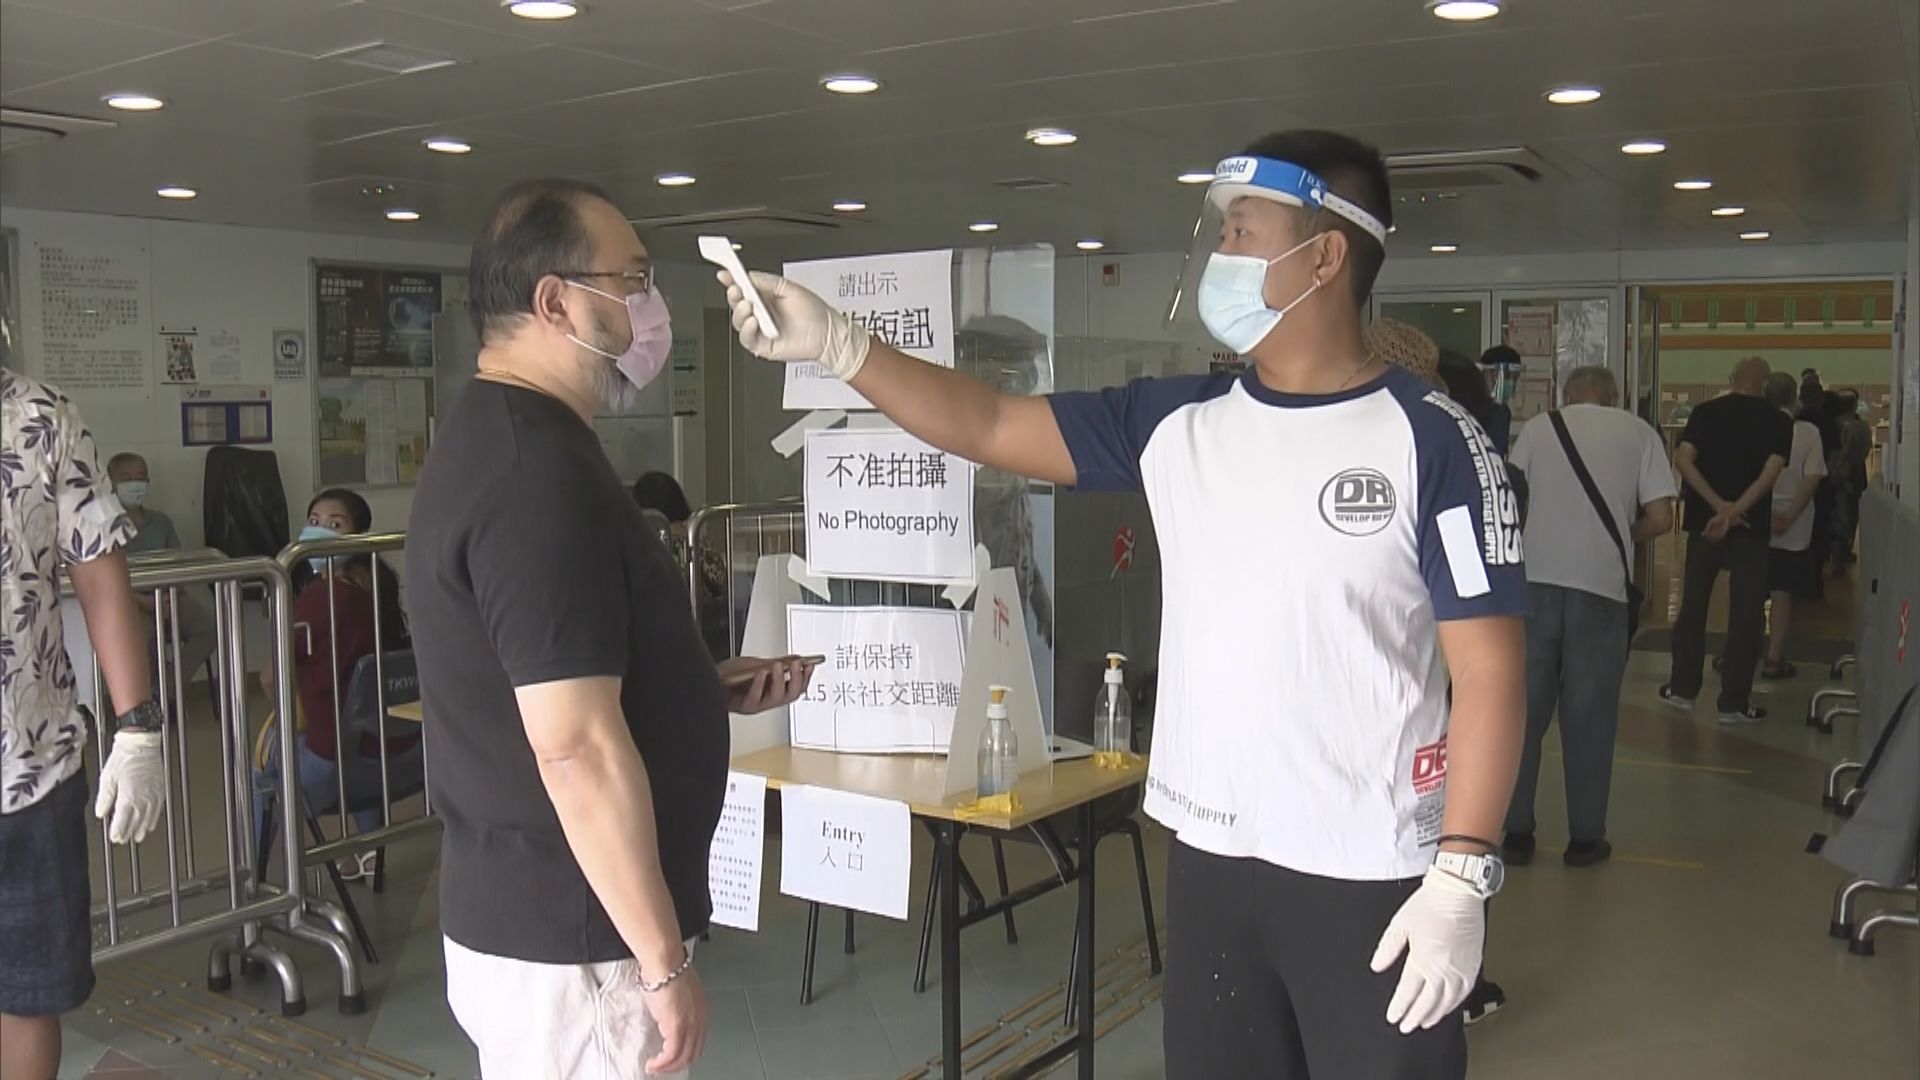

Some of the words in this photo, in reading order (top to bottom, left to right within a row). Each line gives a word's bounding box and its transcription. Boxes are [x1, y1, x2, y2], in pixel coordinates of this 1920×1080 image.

[838, 270, 898, 298] 請出示
[826, 452, 948, 489] 不准拍攝
[818, 511, 839, 529] No
[844, 510, 959, 536] Photography
[1484, 524, 1497, 565] SUPPLY
[836, 643, 913, 670] 請保持
[821, 820, 867, 849] Entry
